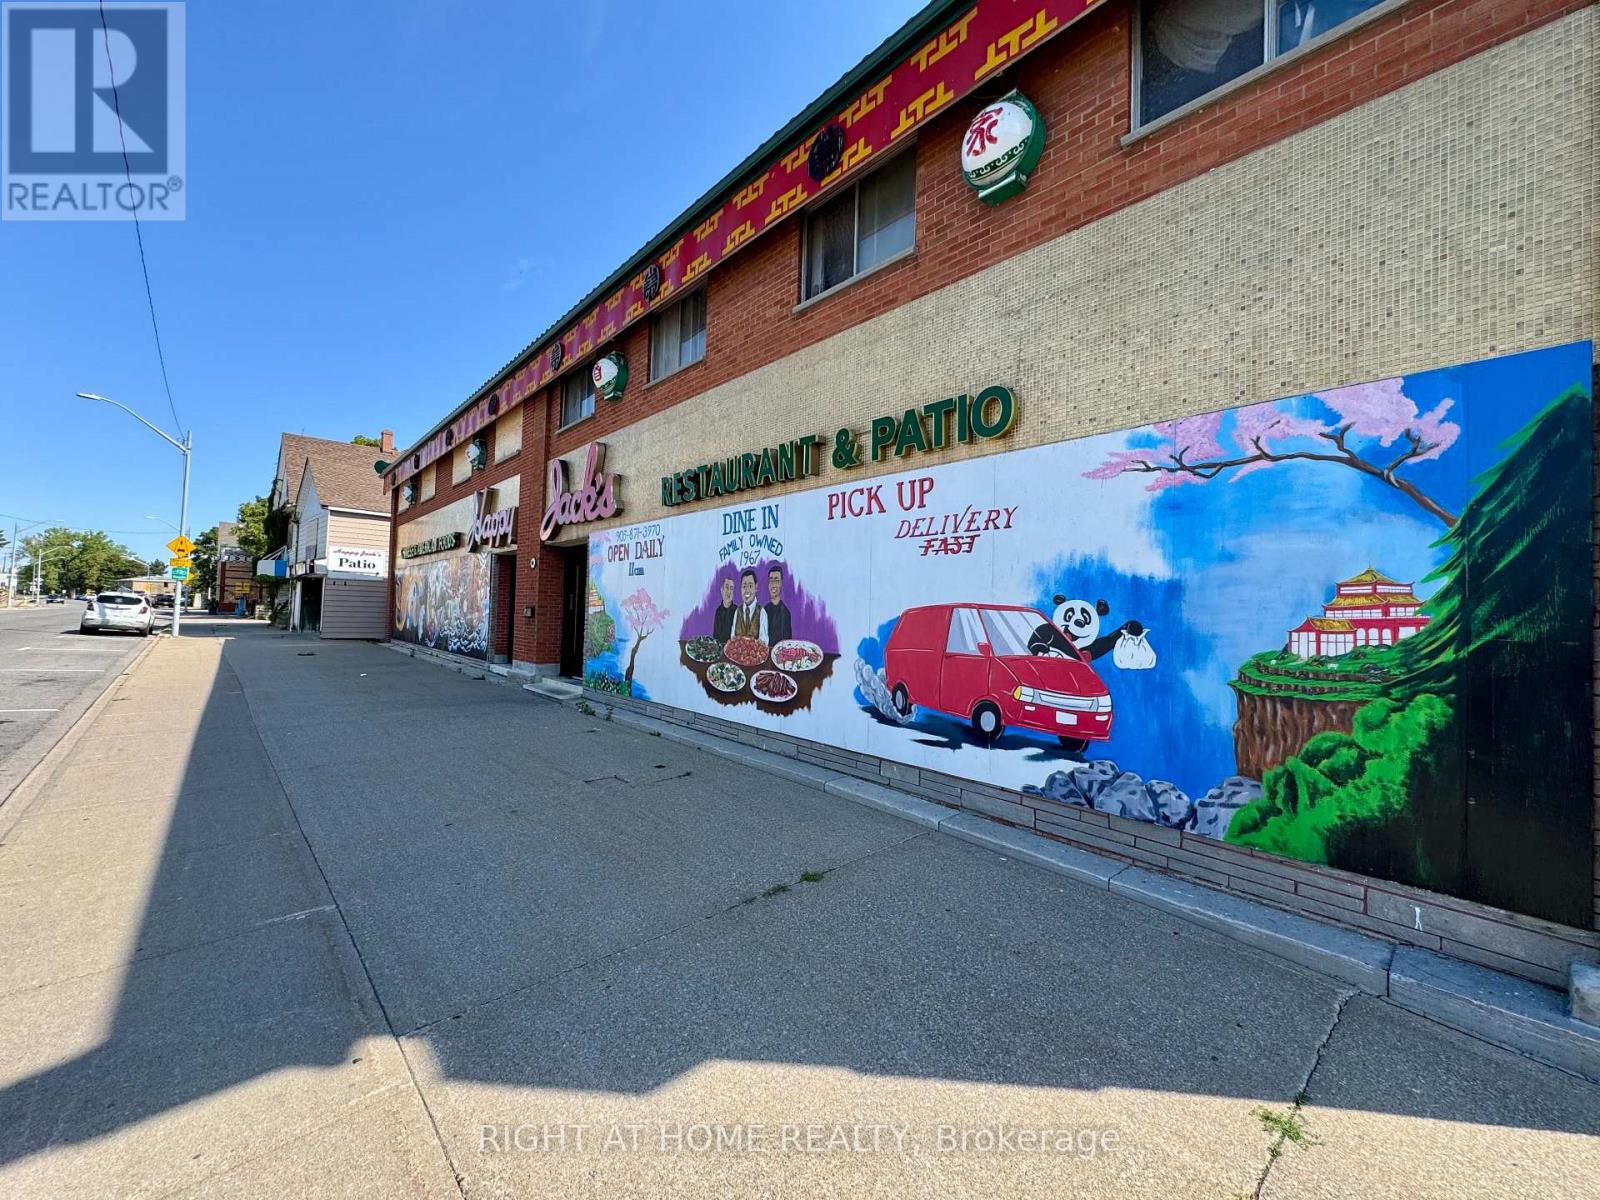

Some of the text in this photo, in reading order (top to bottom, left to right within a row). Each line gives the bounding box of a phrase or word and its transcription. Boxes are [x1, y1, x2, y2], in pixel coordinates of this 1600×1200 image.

[661, 385, 1018, 507] RESTAURANT & PATIO
[540, 441, 622, 542] Jack's
[827, 476, 935, 521] PICK UP
[467, 487, 516, 552] Happy
[722, 504, 780, 536] DINE IN
[894, 504, 1019, 539] DELIVERY
[607, 534, 665, 563] OPEN DAILY
[718, 535, 783, 562] FAMILY OWNED
[740, 549, 761, 567] 1967
[918, 533, 980, 557] FAST
[338, 557, 376, 569] Patio
